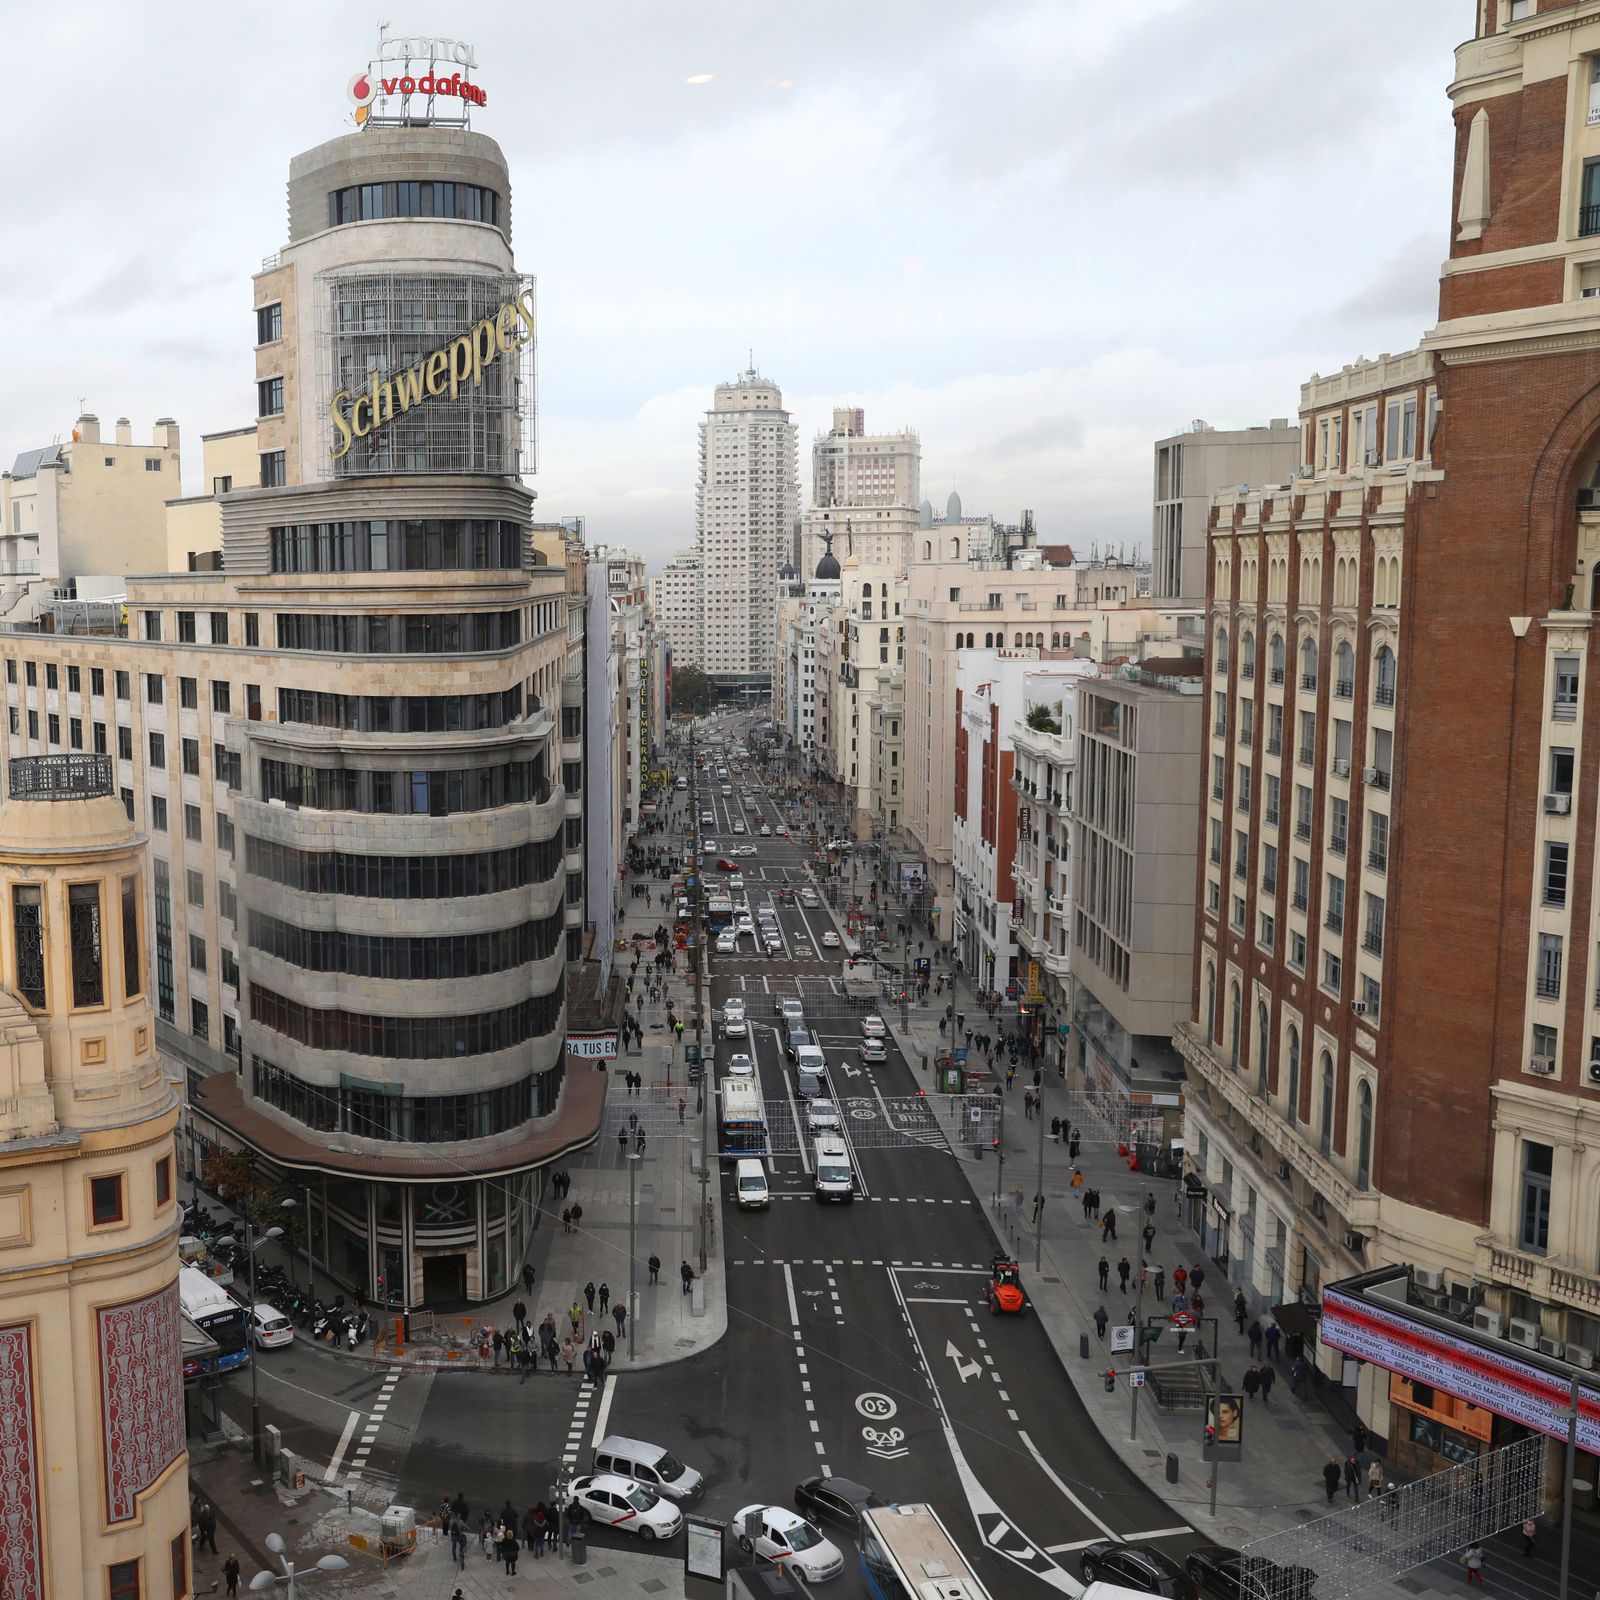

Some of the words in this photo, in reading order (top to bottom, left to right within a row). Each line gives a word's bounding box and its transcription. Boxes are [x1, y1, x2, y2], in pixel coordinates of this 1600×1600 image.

[377, 36, 478, 69] CAPITOL
[381, 70, 487, 107] vodafone
[330, 289, 534, 459] Schweppes
[640, 659, 648, 705] HOTEL
[640, 710, 648, 792] EMPERADOR
[920, 959, 928, 968] P
[583, 1042, 602, 1055] TUS
[892, 1102, 923, 1110] TAXI
[898, 1114, 928, 1122] BUS
[1327, 1293, 1341, 1304] EYAL
[1342, 1298, 1371, 1315] WEIZMAN
[1377, 1311, 1408, 1330] FORENSIC
[1408, 1323, 1457, 1348] ARCHITECTURE
[1466, 1345, 1484, 1359] JOAN
[1486, 1353, 1536, 1378] FONTCUBERTA
[1546, 1376, 1600, 1403] CLUSTDUCK
[1334, 1326, 1354, 1340] MARTA
[1356, 1335, 1382, 1351] PEIRANO
[1391, 1348, 1420, 1366] ELEANOR
[1421, 1360, 1442, 1375] SAITTA
[1452, 1373, 1481, 1390] NICOLAS
[1483, 1385, 1514, 1404] MAIGRET
[1340, 1318, 1360, 1332] FELIPE
[1369, 1330, 1378, 1339] GIL
[1387, 1337, 1412, 1352] MANUEL
[1415, 1348, 1443, 1364] BARTUAL
[1452, 1362, 1478, 1378] NATALIE
[1480, 1373, 1498, 1386] KANE
[1507, 1384, 1532, 1400] TOBIAS
[864, 1399, 888, 1413] 30
[1336, 1337, 1363, 1354] ELEANOR
[1364, 1349, 1385, 1363] SAITTA
[1394, 1360, 1414, 1375] BRUCE
[1416, 1369, 1447, 1388] STERLING
[1456, 1385, 1469, 1396] THE
[1471, 1391, 1503, 1410] INTERNET
[1576, 1434, 1590, 1446] LAS
